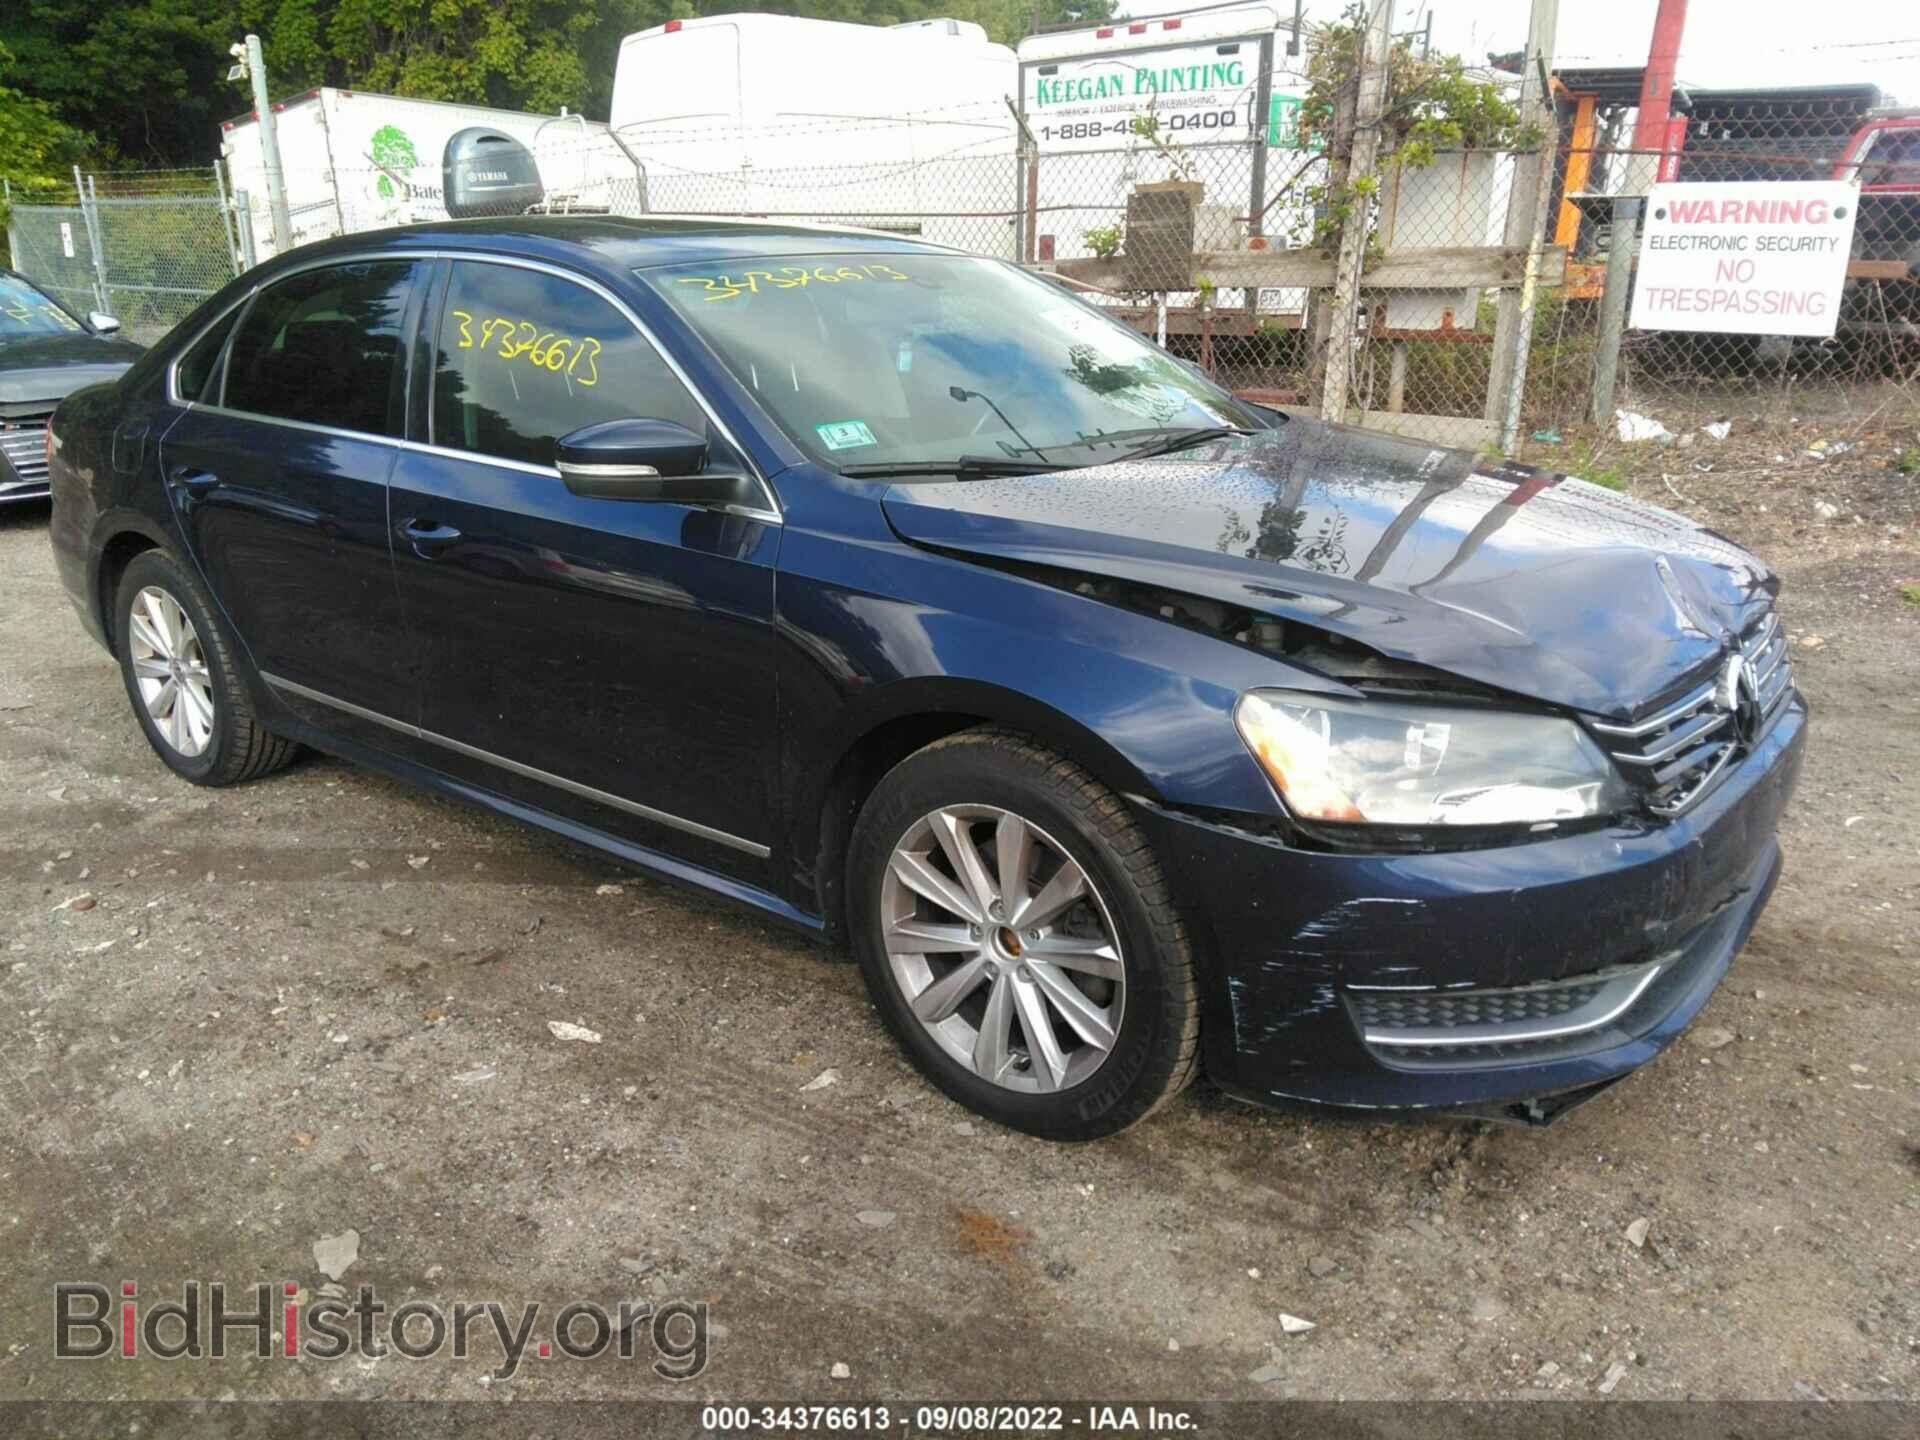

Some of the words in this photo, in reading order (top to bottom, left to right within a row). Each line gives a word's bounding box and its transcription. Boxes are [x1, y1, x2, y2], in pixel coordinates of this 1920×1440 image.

[1036, 72, 1124, 107] KEEGAN
[1135, 61, 1244, 96] PAINTING
[1041, 110, 1237, 142] 1-888-49-0400
[1668, 199, 1829, 225] WARNING
[1650, 235, 1749, 251] ELECTRONIC
[1755, 235, 1839, 253] SECURITY
[676, 265, 910, 301] 34376613
[1715, 258, 1755, 283] NO
[1646, 287, 1826, 316] TRESPASSING
[453, 311, 602, 386] 34376613
[838, 427, 849, 437] 3
